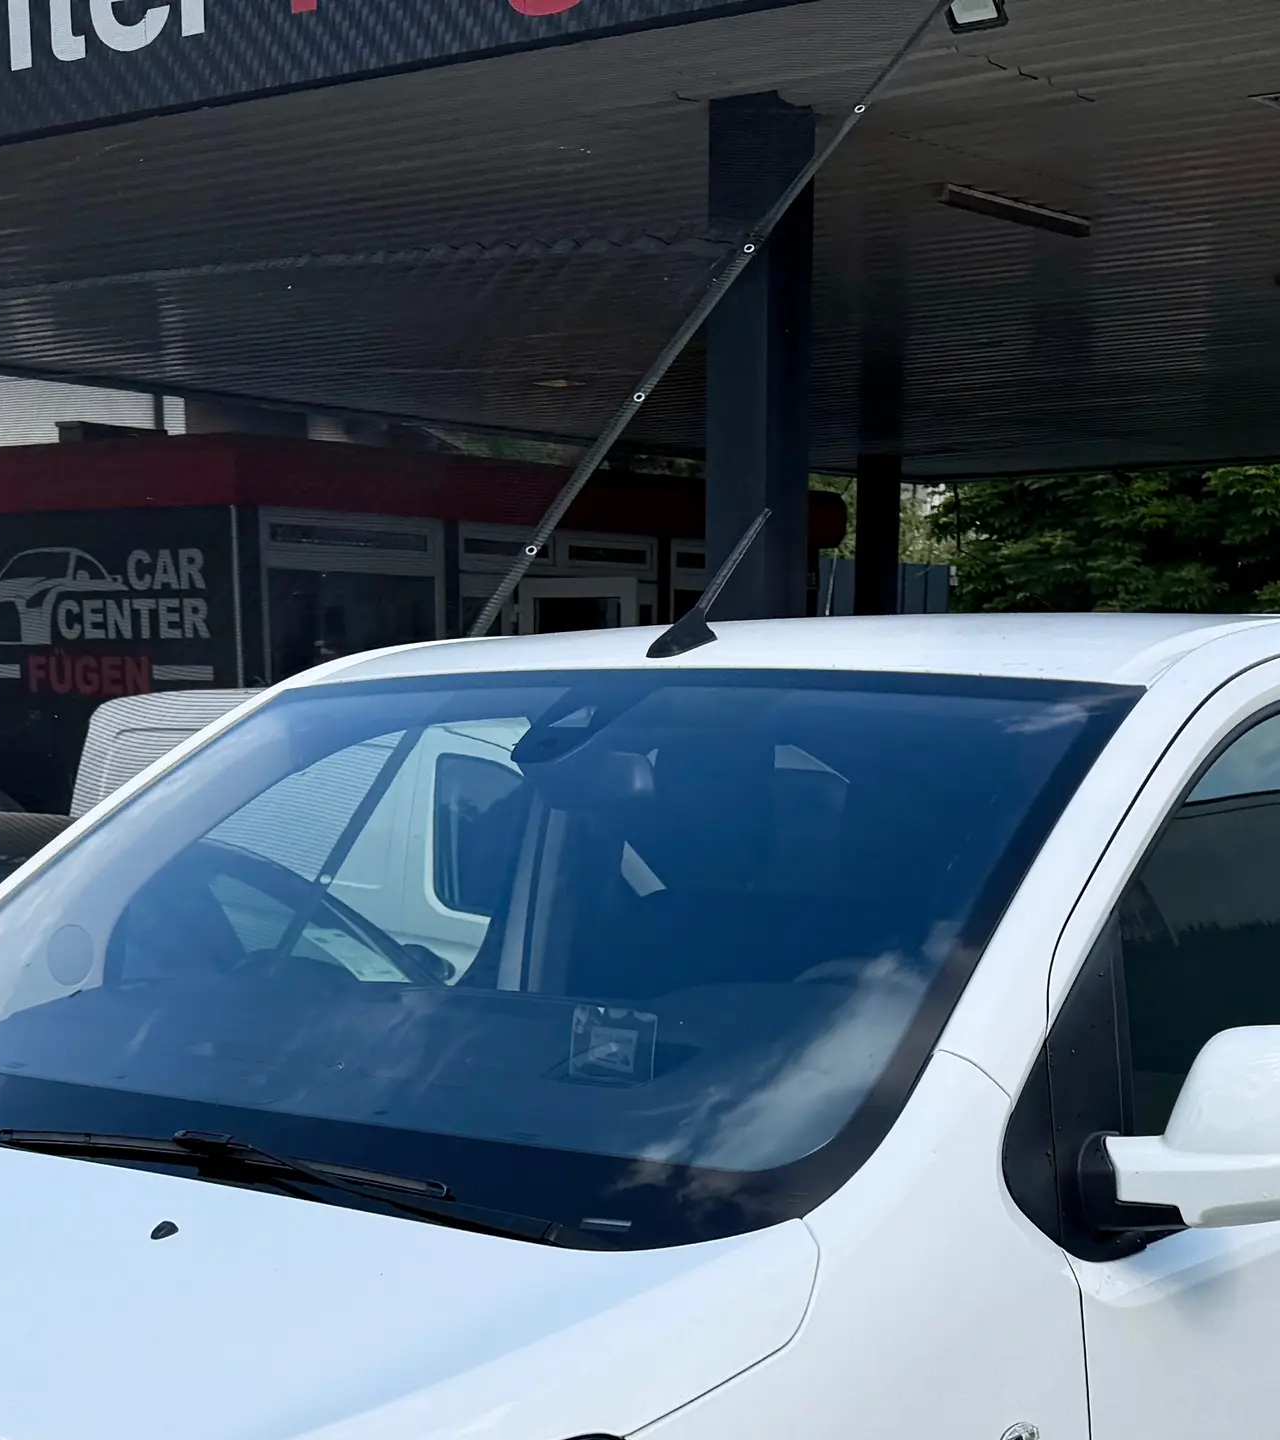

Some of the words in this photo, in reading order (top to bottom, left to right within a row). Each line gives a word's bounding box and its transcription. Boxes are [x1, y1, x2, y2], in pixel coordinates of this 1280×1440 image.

[126, 547, 207, 591] CAR
[56, 597, 211, 640] CENTER
[27, 647, 151, 695] FÜGEN
